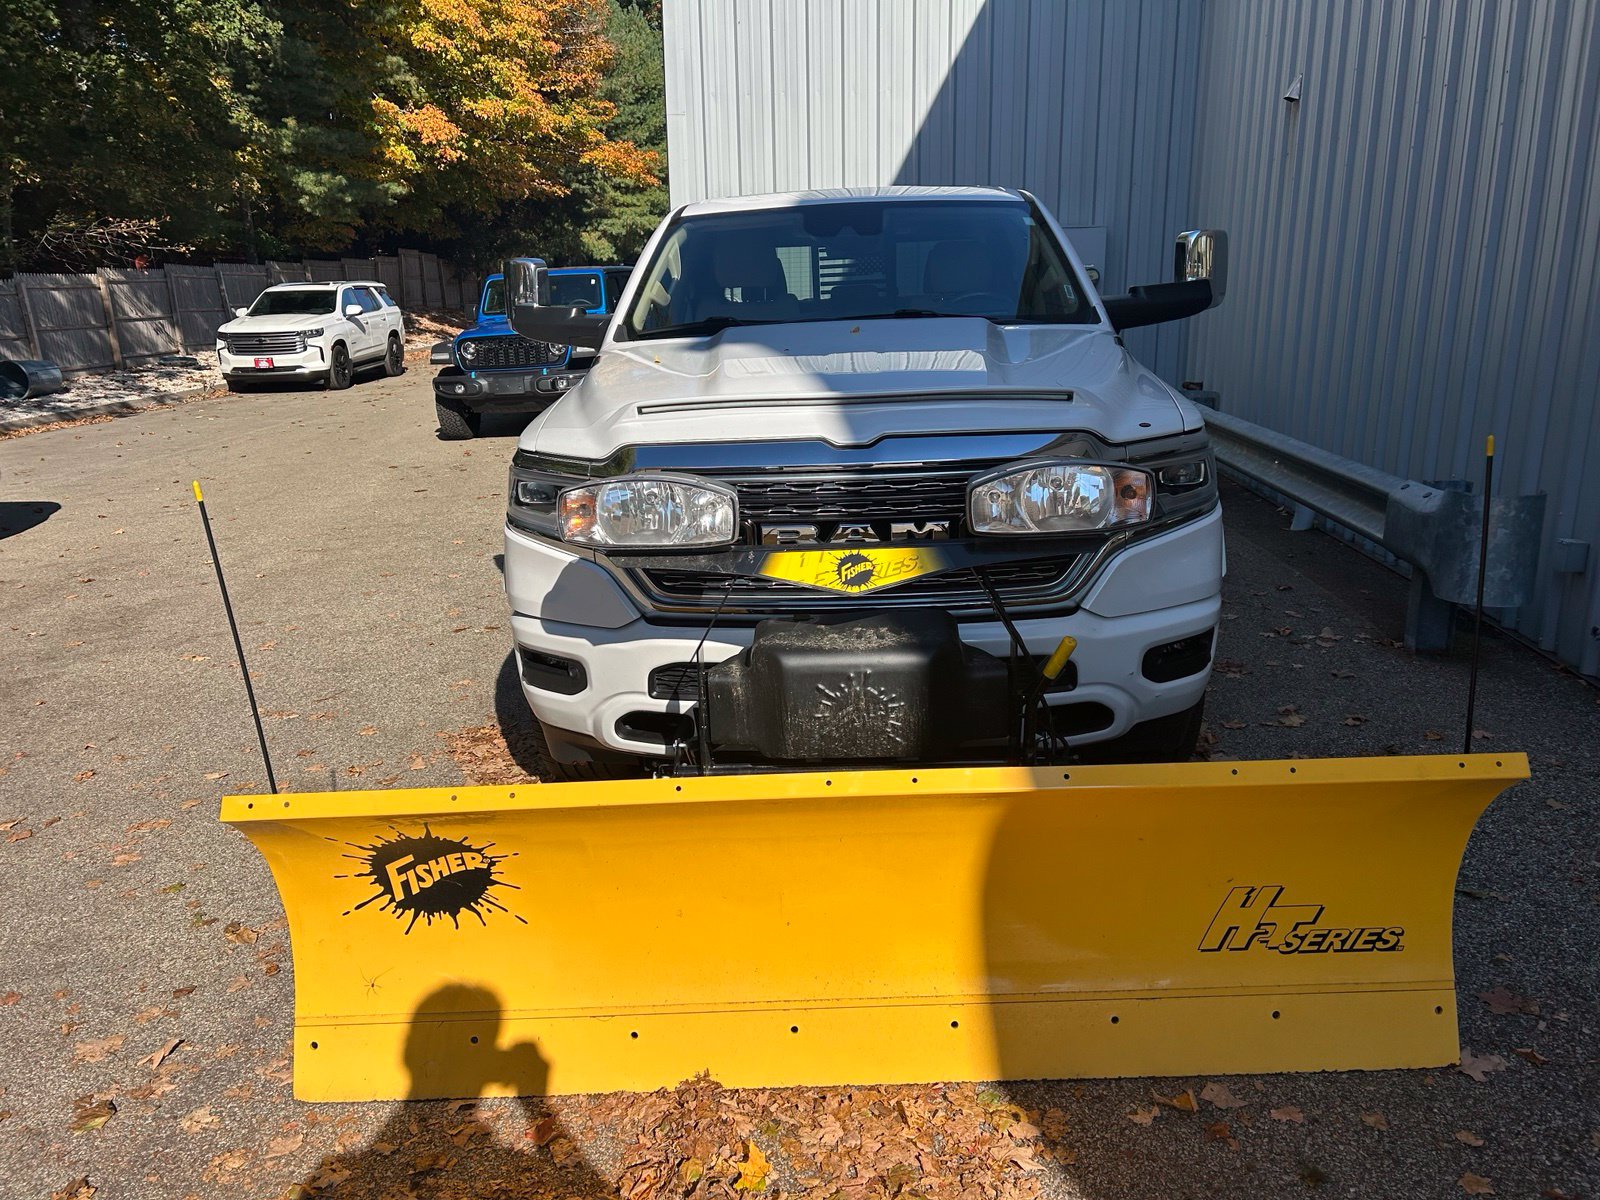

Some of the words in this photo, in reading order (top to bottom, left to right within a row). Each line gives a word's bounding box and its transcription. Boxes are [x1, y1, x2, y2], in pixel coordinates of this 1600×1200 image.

[761, 521, 950, 545] RAM
[841, 561, 875, 581] FISHER
[385, 851, 489, 903] FISHER
[1278, 926, 1404, 954] SERIES
